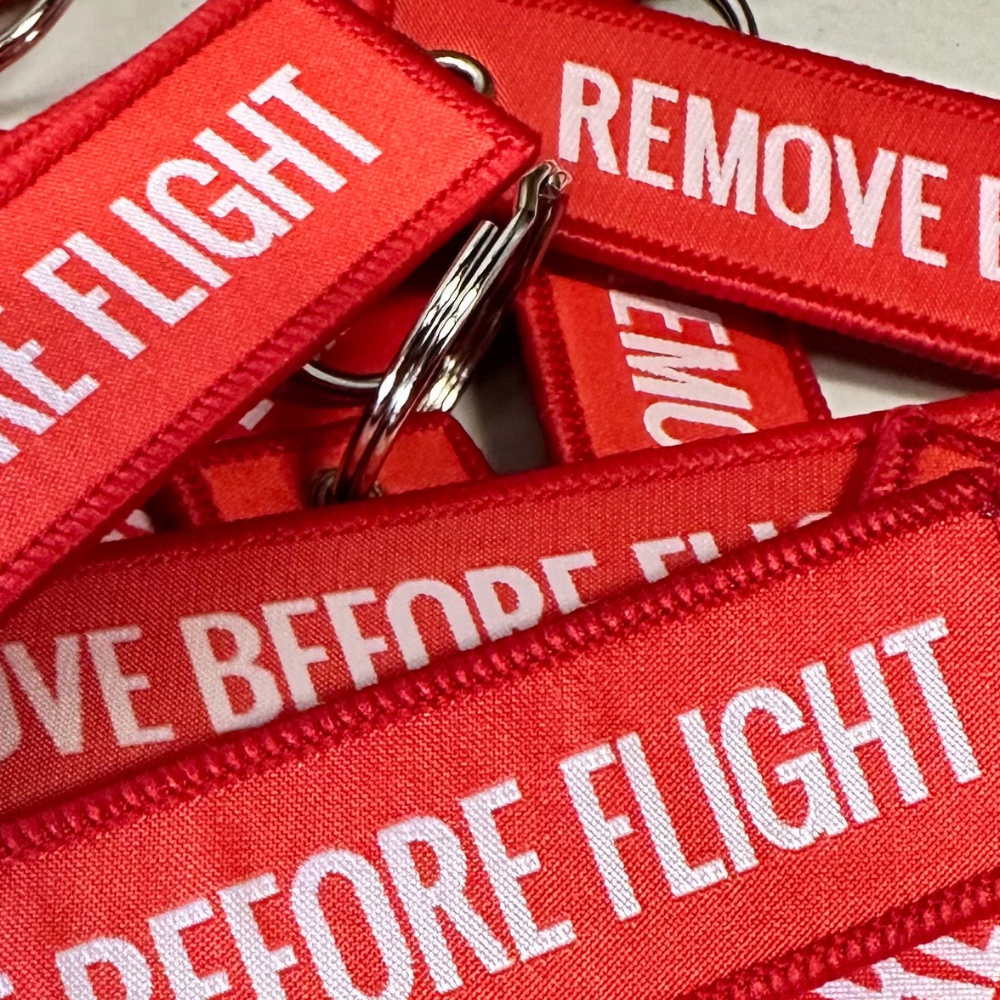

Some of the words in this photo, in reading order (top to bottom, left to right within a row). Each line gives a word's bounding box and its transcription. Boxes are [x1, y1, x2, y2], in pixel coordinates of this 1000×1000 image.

[22, 63, 382, 360] FLIGHT
[558, 61, 949, 269] REMOVE
[558, 615, 983, 921] FLIGHT
